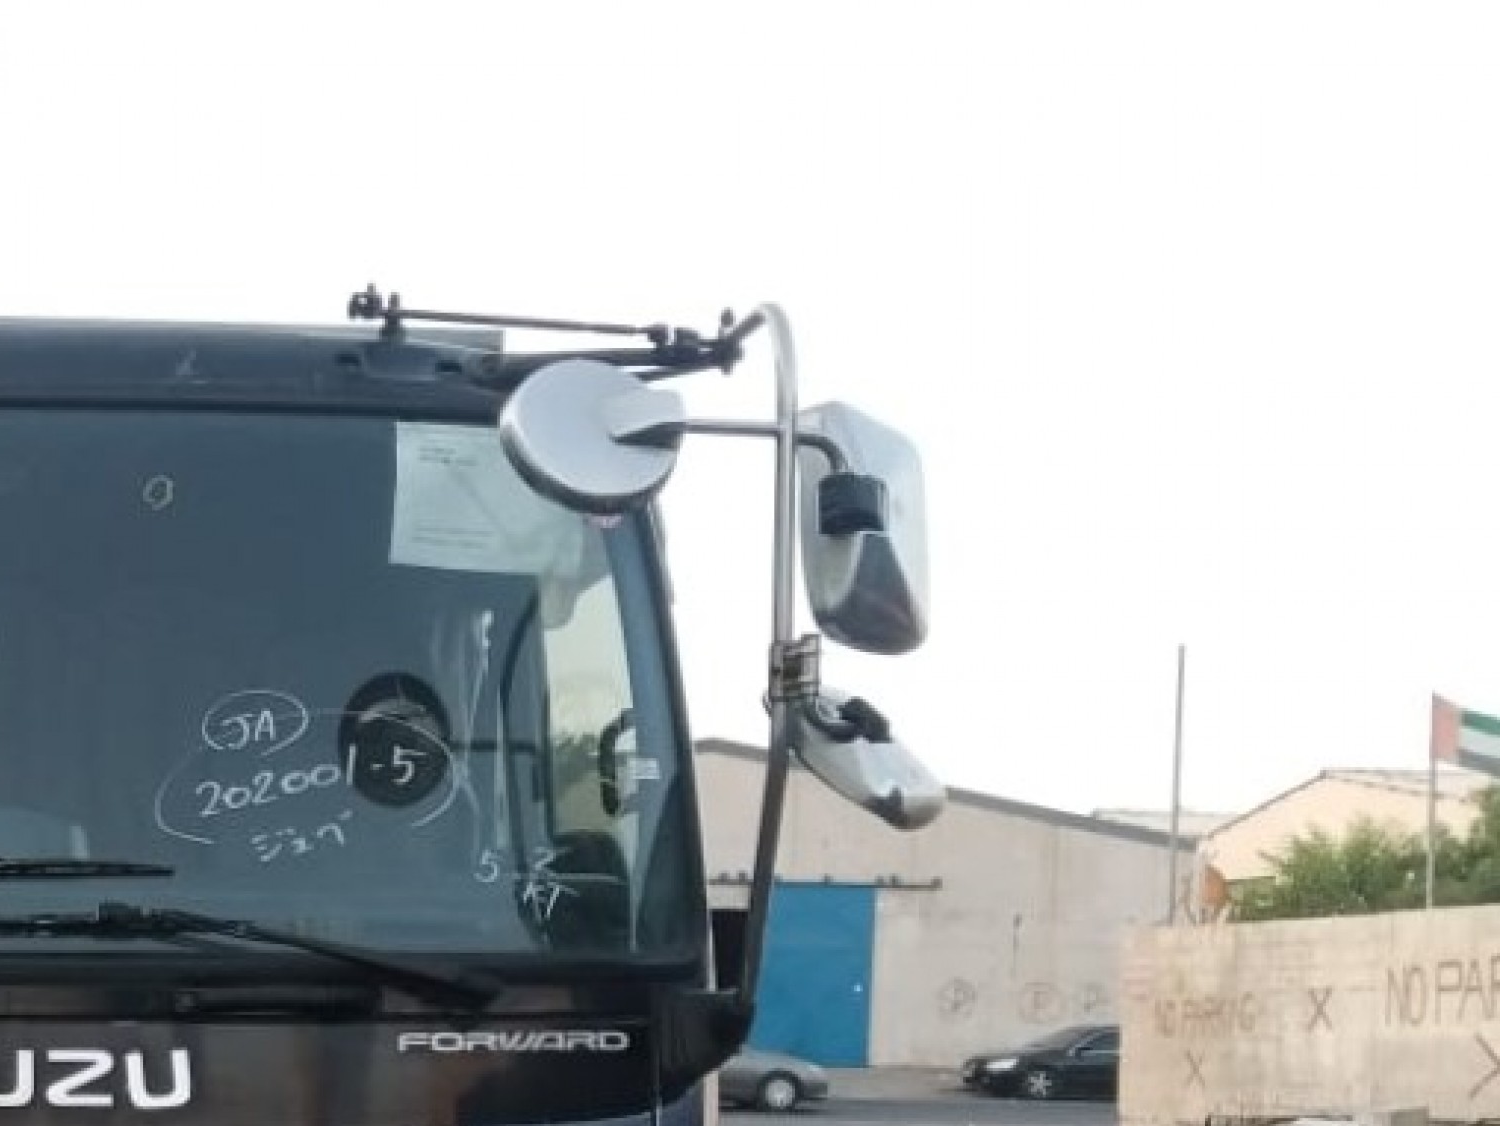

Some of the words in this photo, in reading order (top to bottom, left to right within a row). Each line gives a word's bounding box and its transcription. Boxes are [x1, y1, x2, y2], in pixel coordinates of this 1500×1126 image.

[221, 708, 277, 750] JA
[195, 743, 429, 818] 202001-5
[1384, 964, 1428, 1028] NO
[397, 1031, 630, 1052] FORWARD
